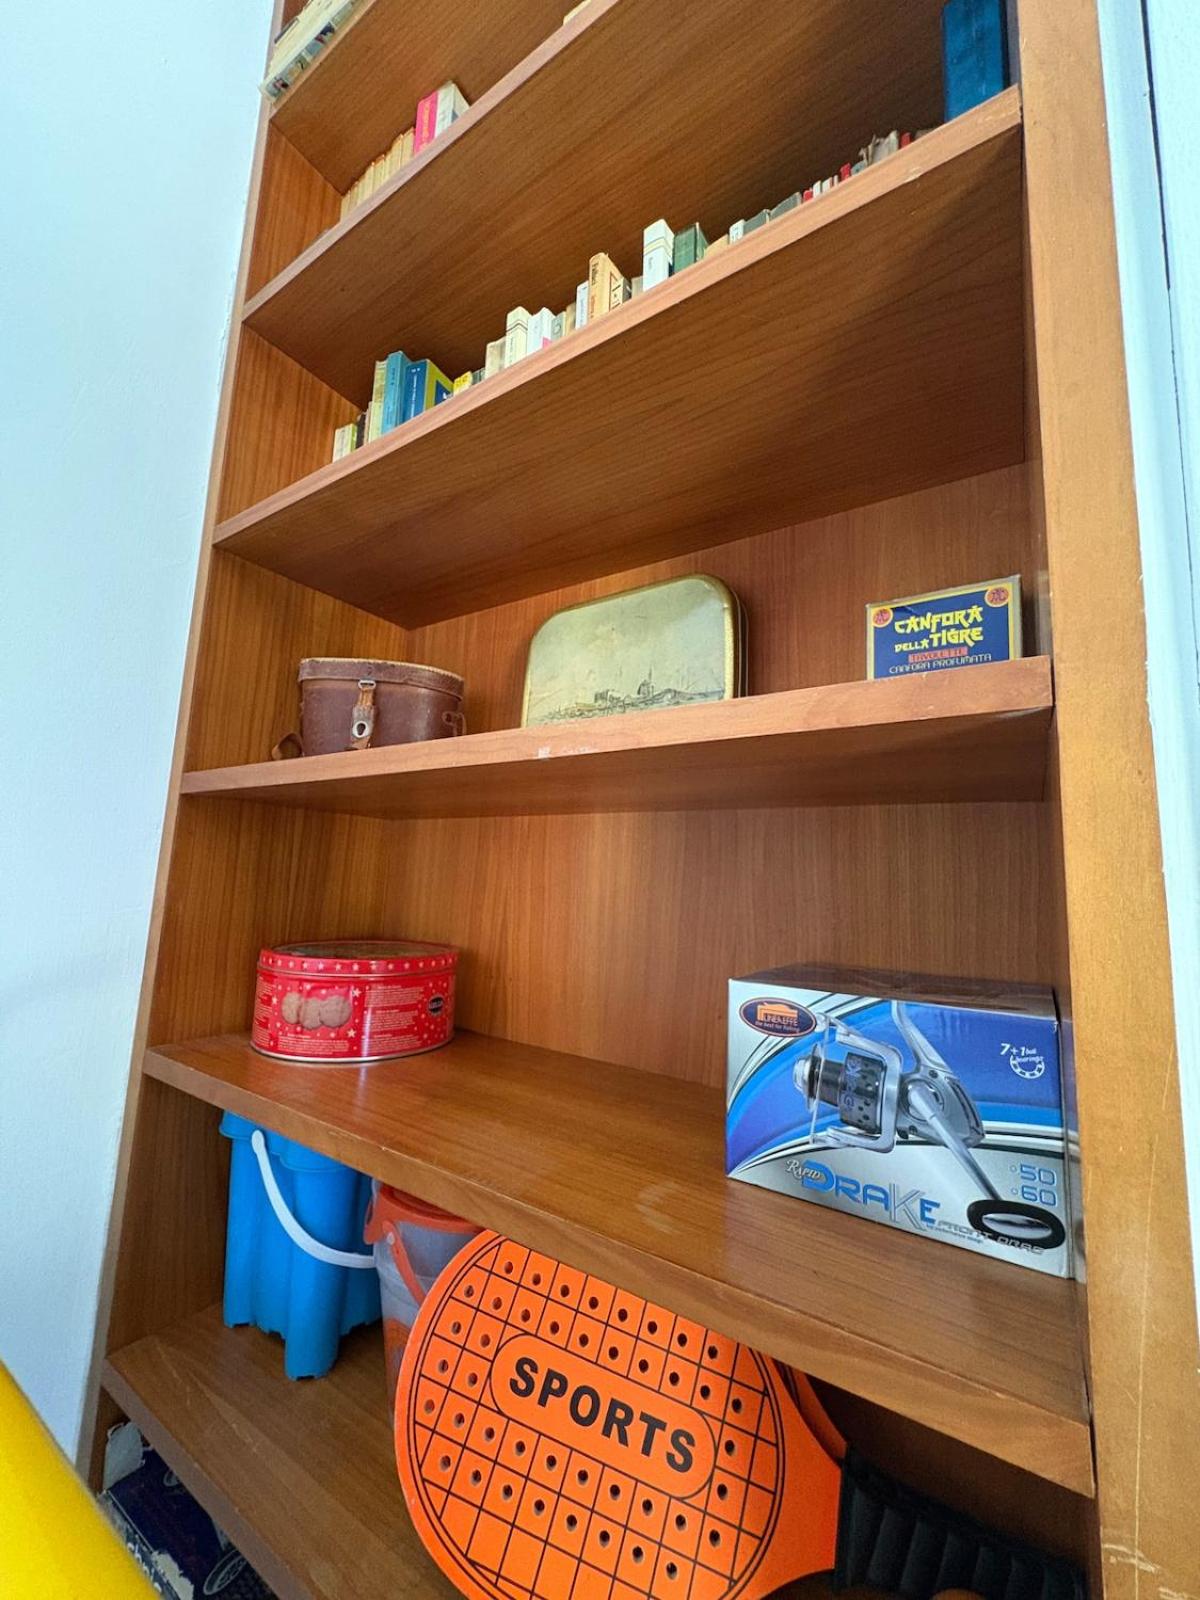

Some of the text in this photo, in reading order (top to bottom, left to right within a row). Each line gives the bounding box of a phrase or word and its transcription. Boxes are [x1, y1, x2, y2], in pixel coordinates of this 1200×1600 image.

[894, 605, 983, 634] CANFORA
[894, 627, 984, 653] DELLA TIGRE
[889, 653, 992, 674] CANFORA PROFUMATA
[1020, 1163, 1056, 1186] 50
[801, 1159, 941, 1231] DRAKE
[1021, 1184, 1057, 1206] 60
[509, 1356, 697, 1474] SPORTS
